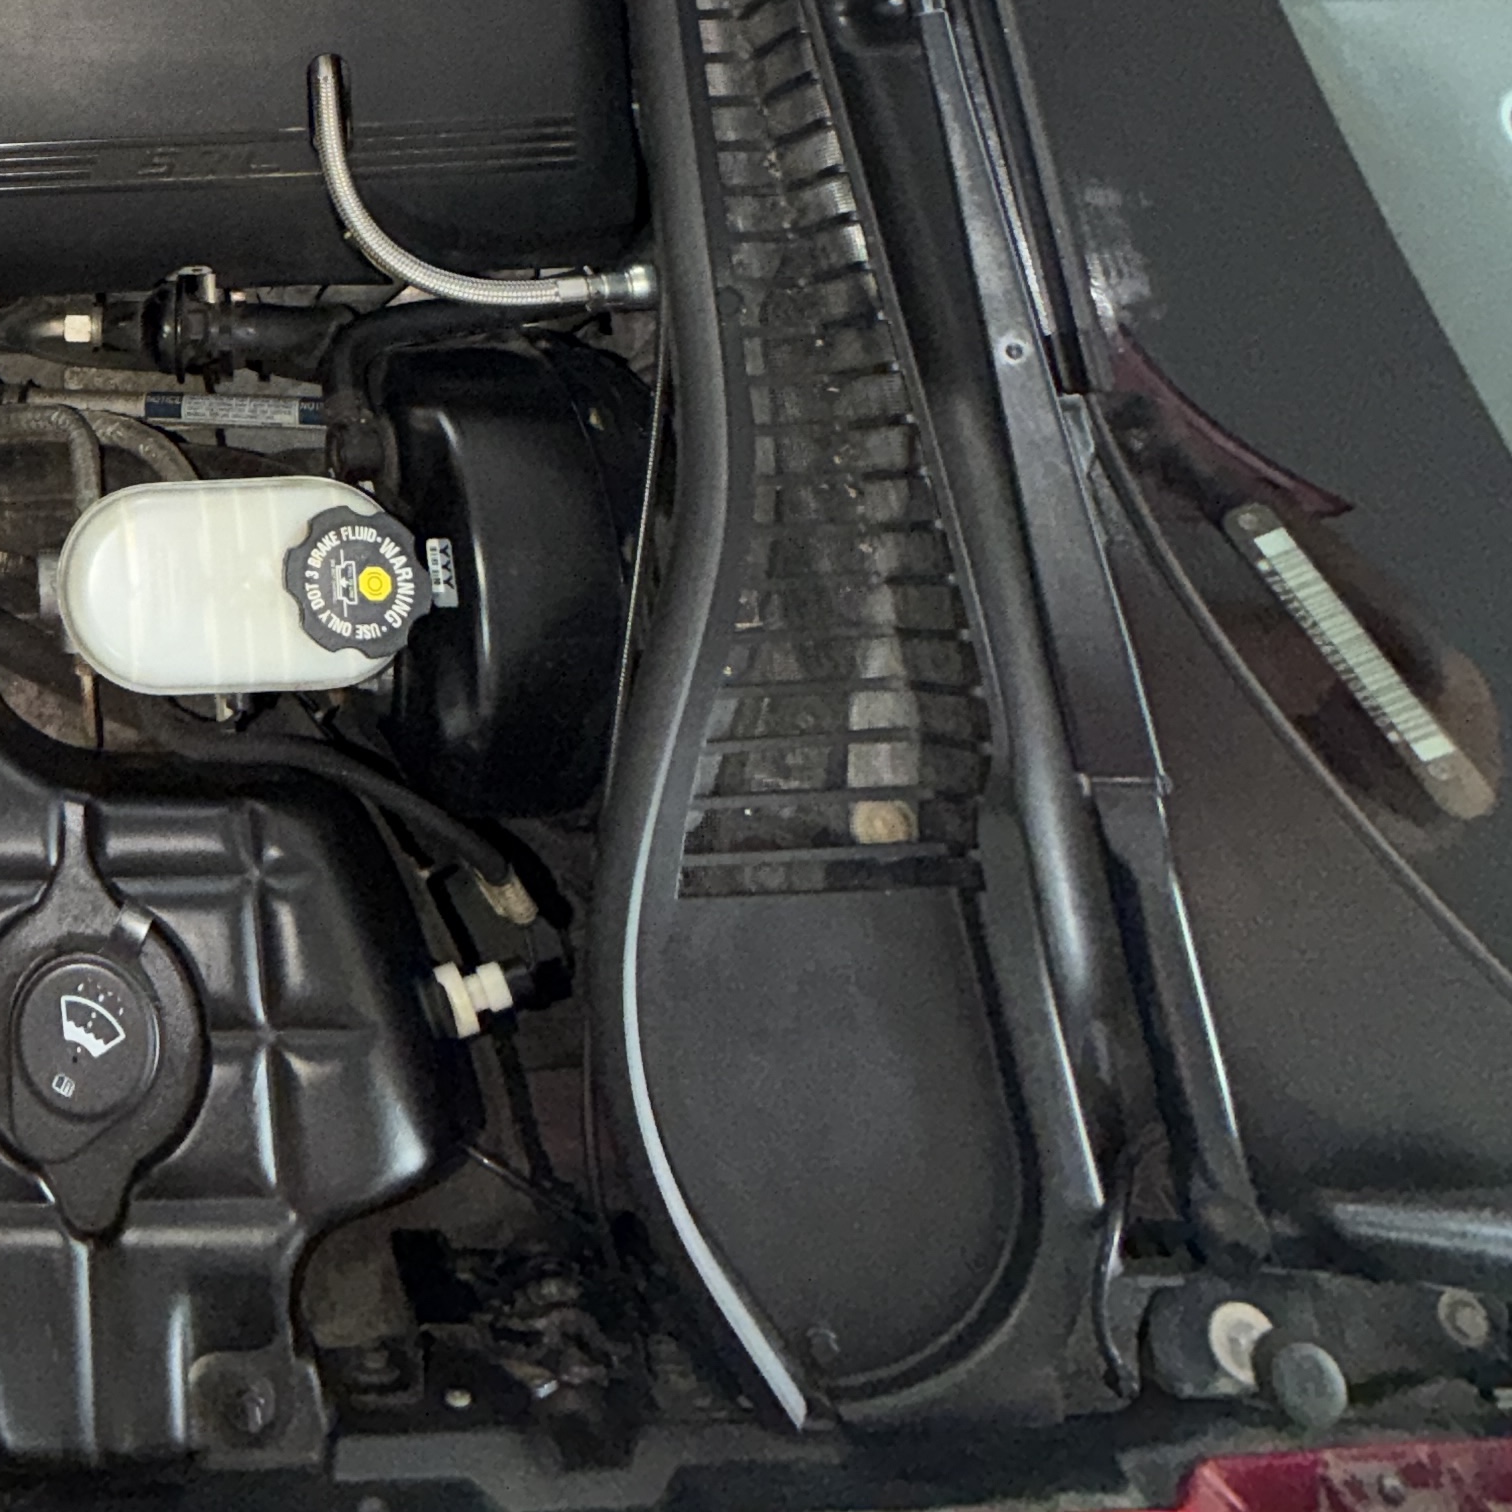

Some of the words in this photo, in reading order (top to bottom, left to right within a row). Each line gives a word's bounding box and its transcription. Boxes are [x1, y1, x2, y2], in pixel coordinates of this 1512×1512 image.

[340, 525, 378, 543] FLUID
[307, 530, 341, 569] BRAKE
[305, 570, 320, 580] 3
[439, 544, 455, 590] YYY
[305, 582, 326, 611] DOT
[379, 537, 416, 629] WARNING
[318, 609, 352, 638] ONLY
[355, 623, 382, 640] USE
